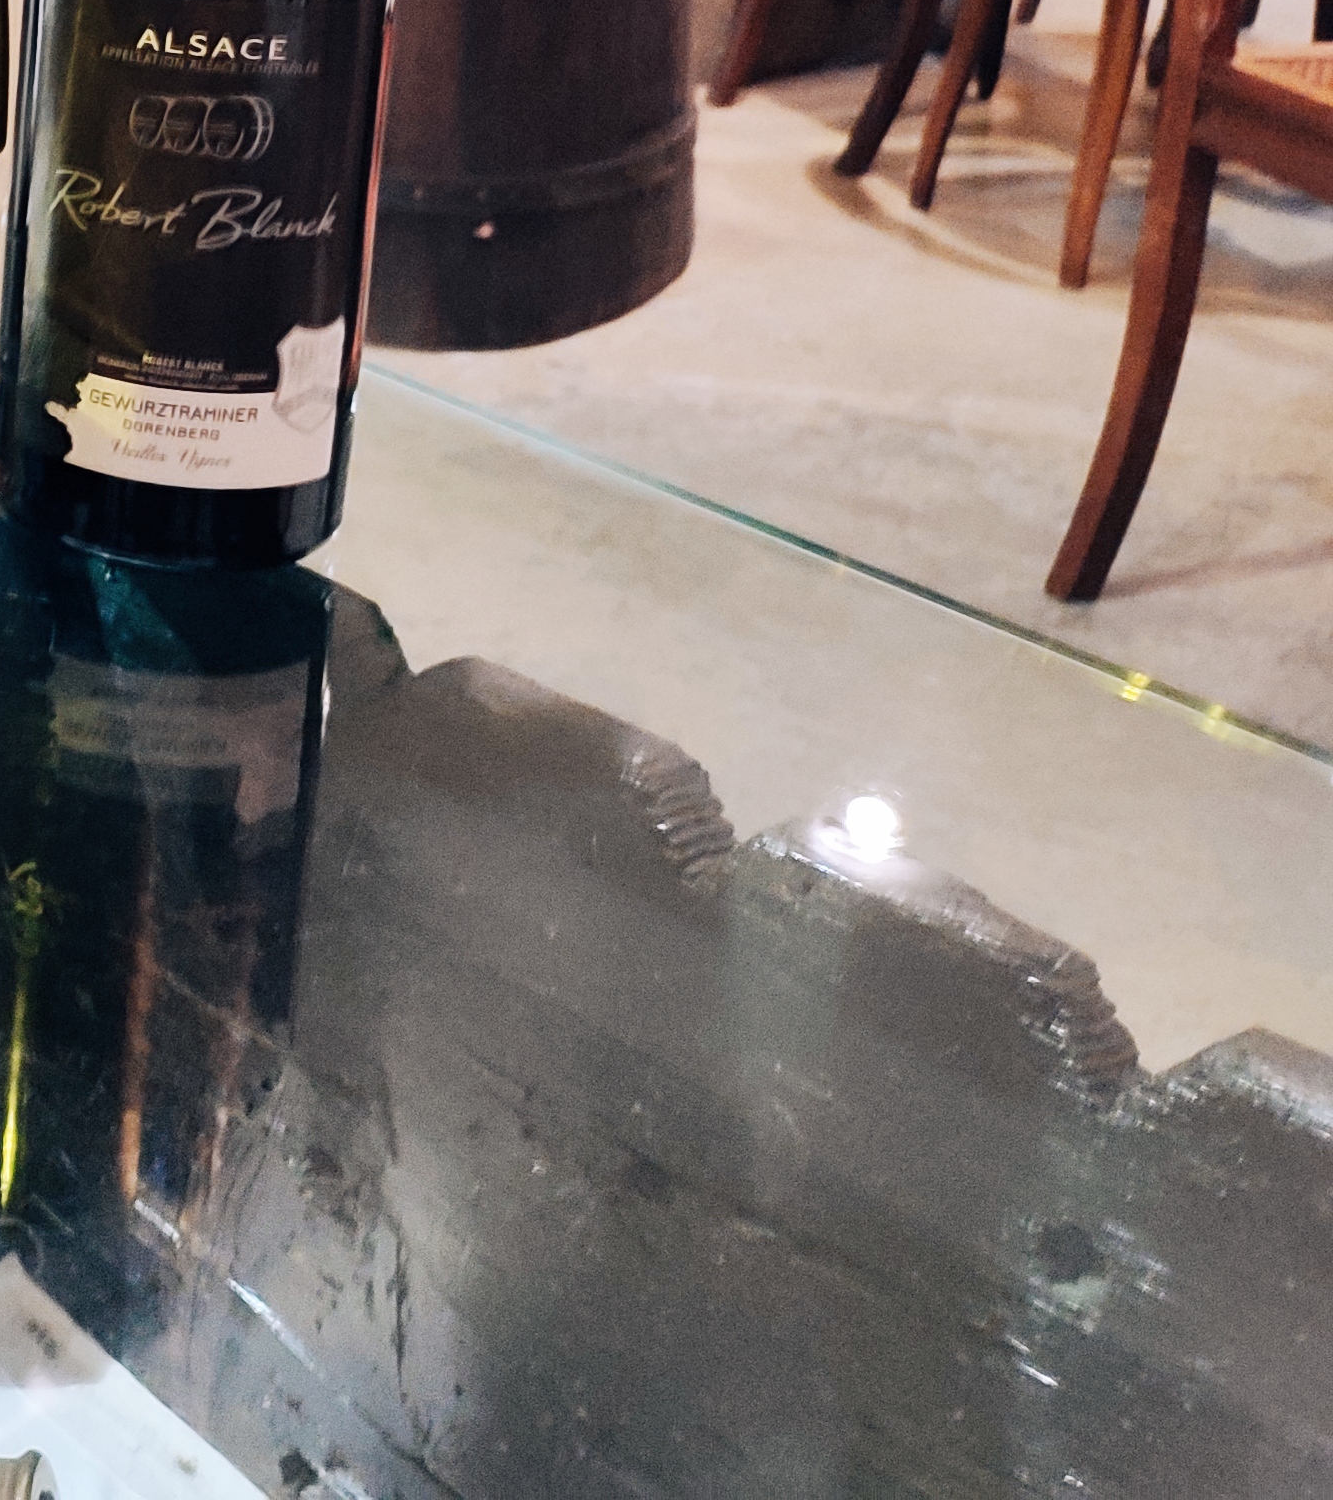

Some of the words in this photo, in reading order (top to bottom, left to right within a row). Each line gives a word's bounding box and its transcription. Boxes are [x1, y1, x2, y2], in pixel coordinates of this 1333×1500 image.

[136, 24, 288, 61] ALSACE
[47, 168, 185, 234] Robert
[191, 187, 339, 250] Blanck
[90, 389, 259, 423] GEWURZTRAMINER
[122, 418, 220, 441] DORENBERG
